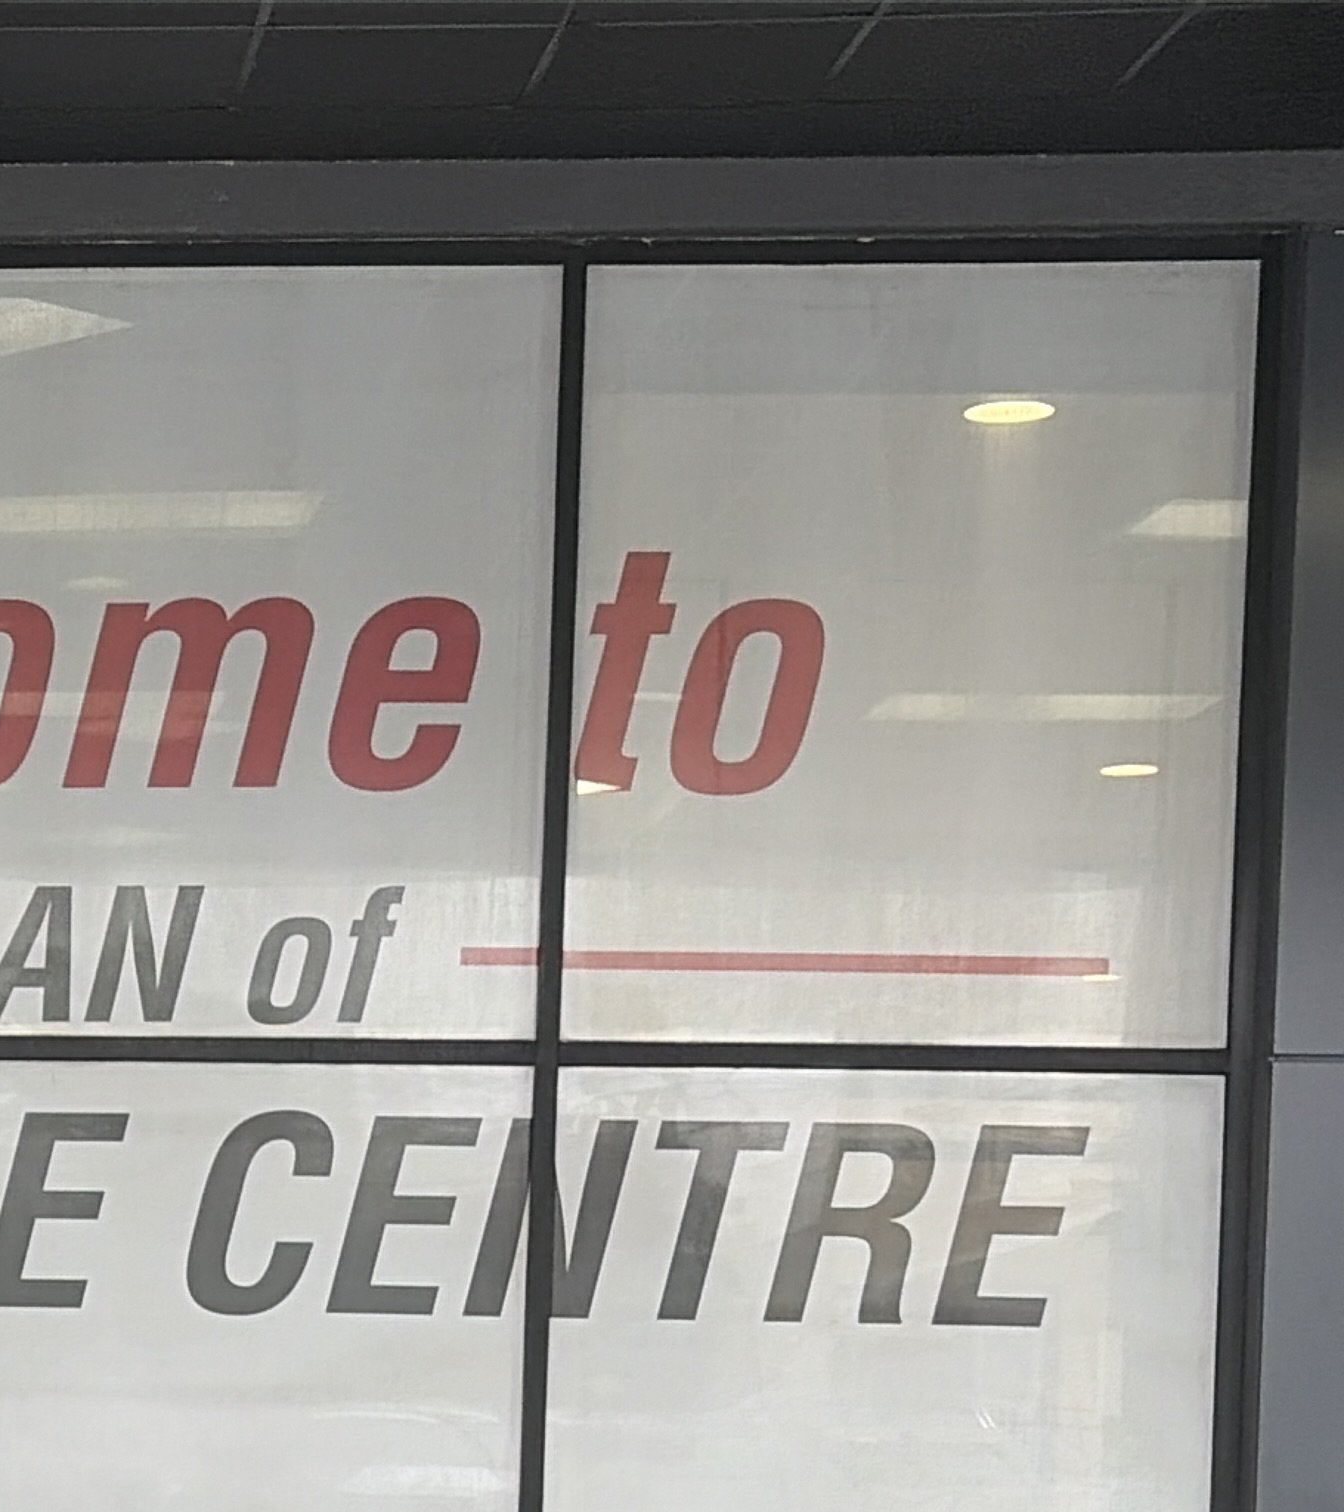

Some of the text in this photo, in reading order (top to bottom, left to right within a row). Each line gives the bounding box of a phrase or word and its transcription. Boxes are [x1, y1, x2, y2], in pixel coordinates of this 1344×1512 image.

[574, 551, 825, 796] to
[245, 886, 406, 1026] of
[184, 1109, 1090, 1329] CENTRE
